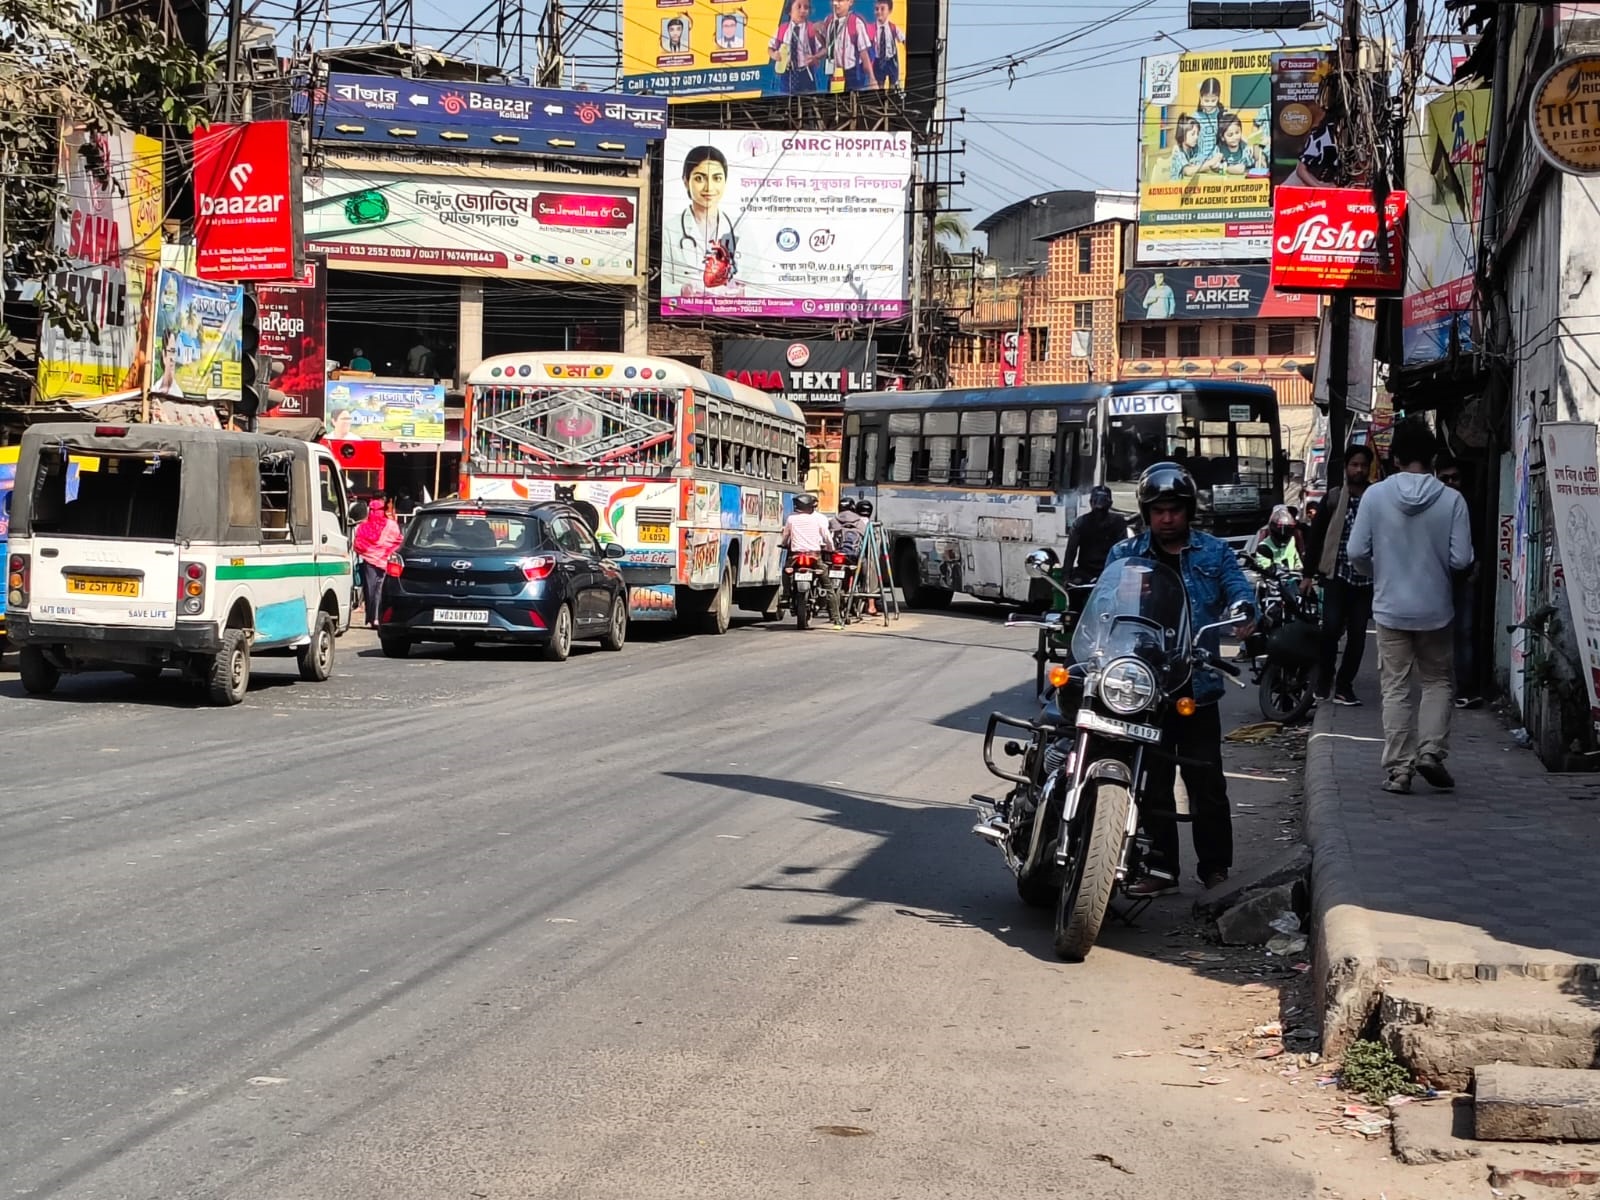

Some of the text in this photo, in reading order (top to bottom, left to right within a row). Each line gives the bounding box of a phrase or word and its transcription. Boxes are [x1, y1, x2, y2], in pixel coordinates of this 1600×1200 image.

[1180, 60, 1200, 73] DELHI
[1201, 57, 1228, 71] WORLD
[1229, 55, 1256, 70] PUBLIC
[628, 79, 644, 89] Call
[334, 84, 399, 102] বাজার
[469, 92, 533, 113] Baazar
[500, 110, 529, 120] Kolkata
[782, 138, 907, 151] GNRC HOSPITALS
[1148, 186, 1182, 195] ADMISSION
[1184, 185, 1202, 194] OPEN
[1203, 185, 1223, 194] FROM
[200, 193, 284, 215] baazar
[415, 189, 528, 214] নিখুঁত জ্যোতিষে
[1180, 197, 1193, 206] FOR
[1195, 196, 1228, 205] ACADEMIC
[1230, 195, 1257, 204] SESSION
[67, 209, 120, 269] SAHA
[813, 233, 836, 247] 24/7
[1277, 214, 1386, 254] Asho
[350, 246, 365, 255] 033
[367, 247, 388, 257] 2552
[1194, 274, 1241, 289] LUX
[1186, 289, 1249, 303] PARKER
[725, 368, 873, 393] SAHA TEXTILE
[281, 397, 301, 409] 70+
[1111, 395, 1175, 413] WBTC
[74, 578, 86, 590] WB
[110, 582, 136, 594] 7872
[128, 609, 167, 619] SAVE LIFE
